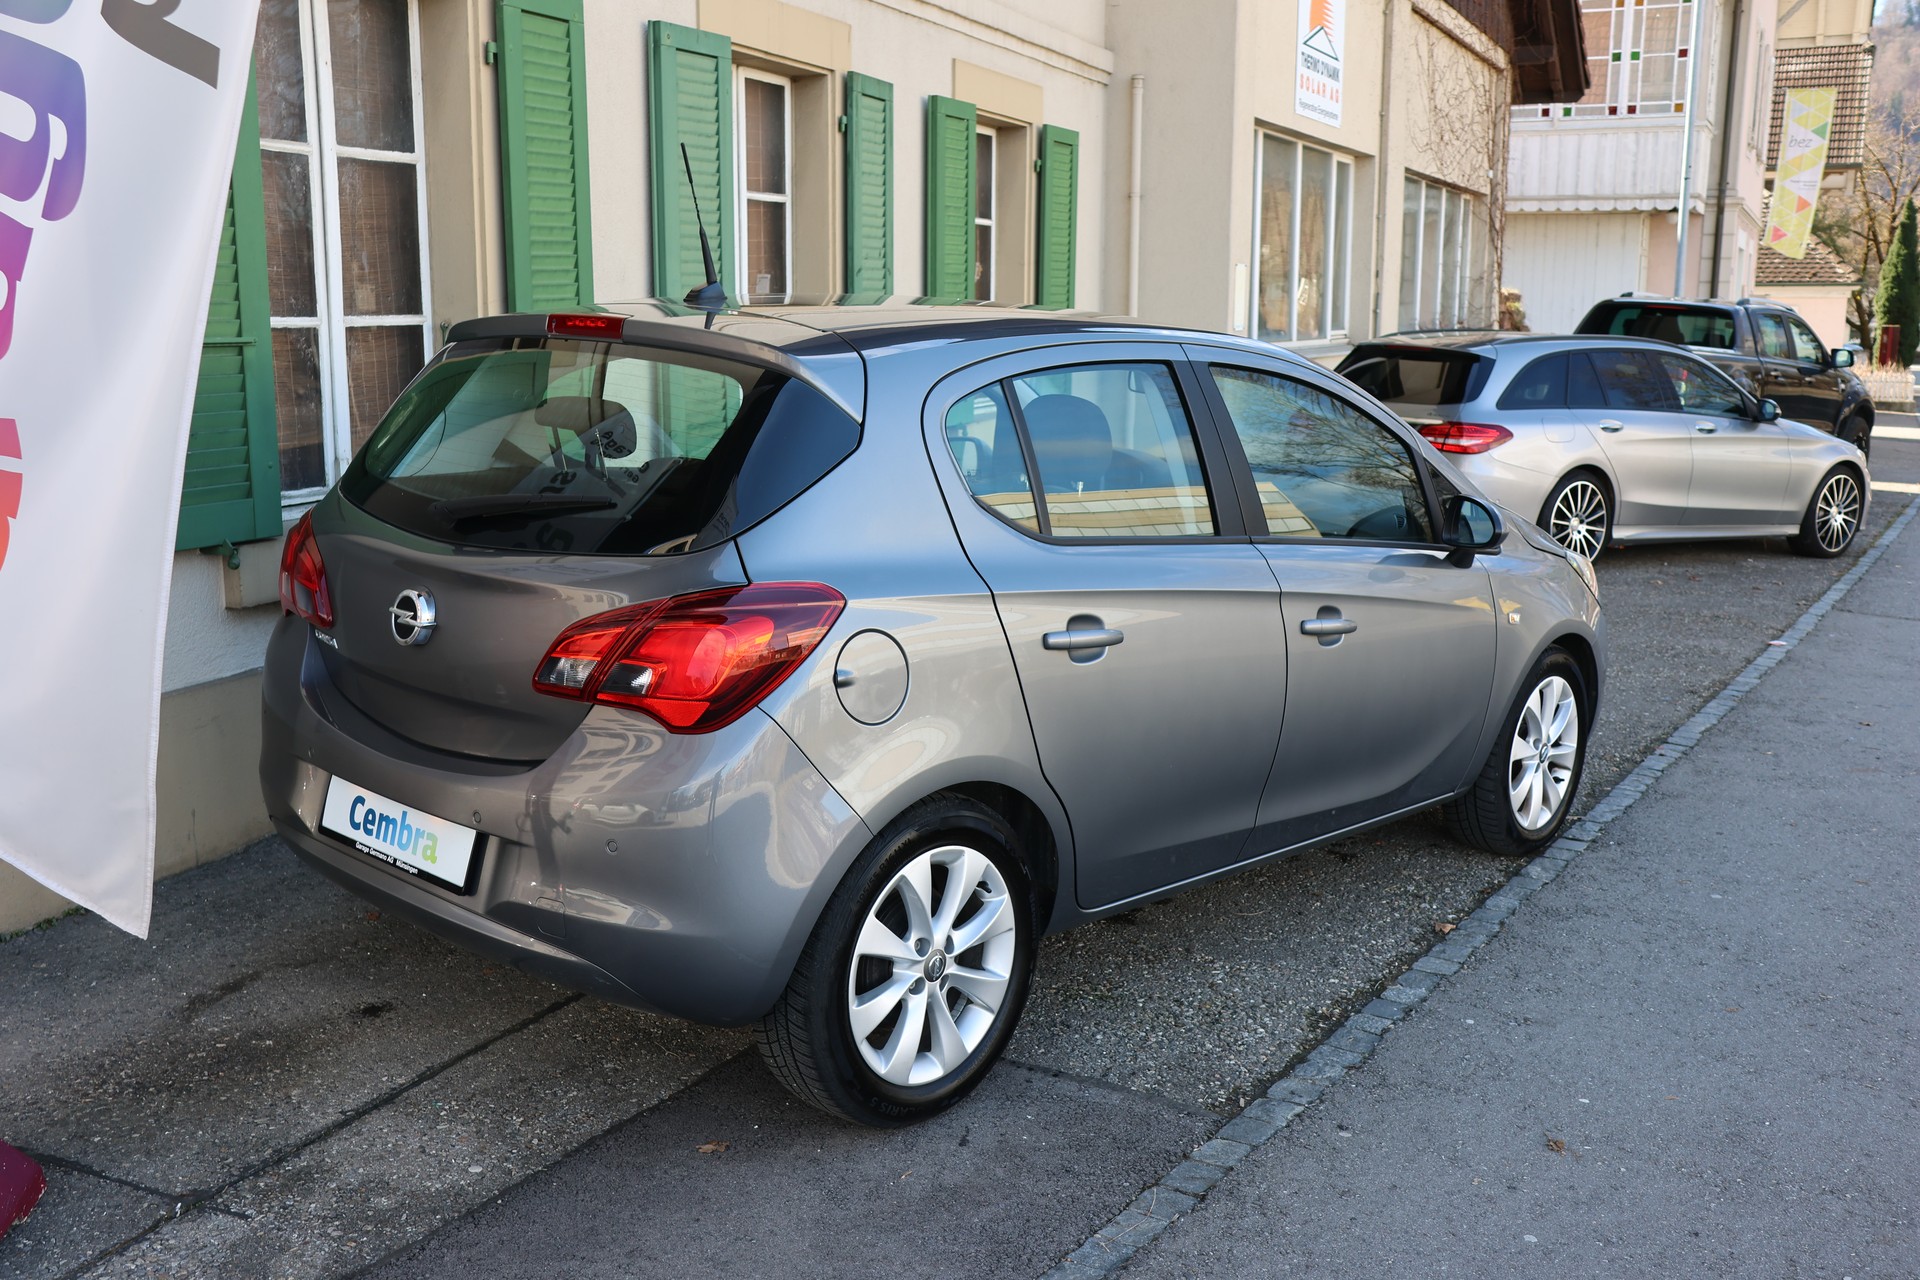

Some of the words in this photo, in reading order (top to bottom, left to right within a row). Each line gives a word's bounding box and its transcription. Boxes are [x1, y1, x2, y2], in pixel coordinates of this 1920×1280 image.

[1300, 73, 1327, 98] SOLAR
[1330, 86, 1339, 104] AG
[349, 795, 438, 865] Cembra
[355, 841, 369, 854] Garage
[370, 847, 387, 861] Germano
[387, 855, 394, 864] AG
